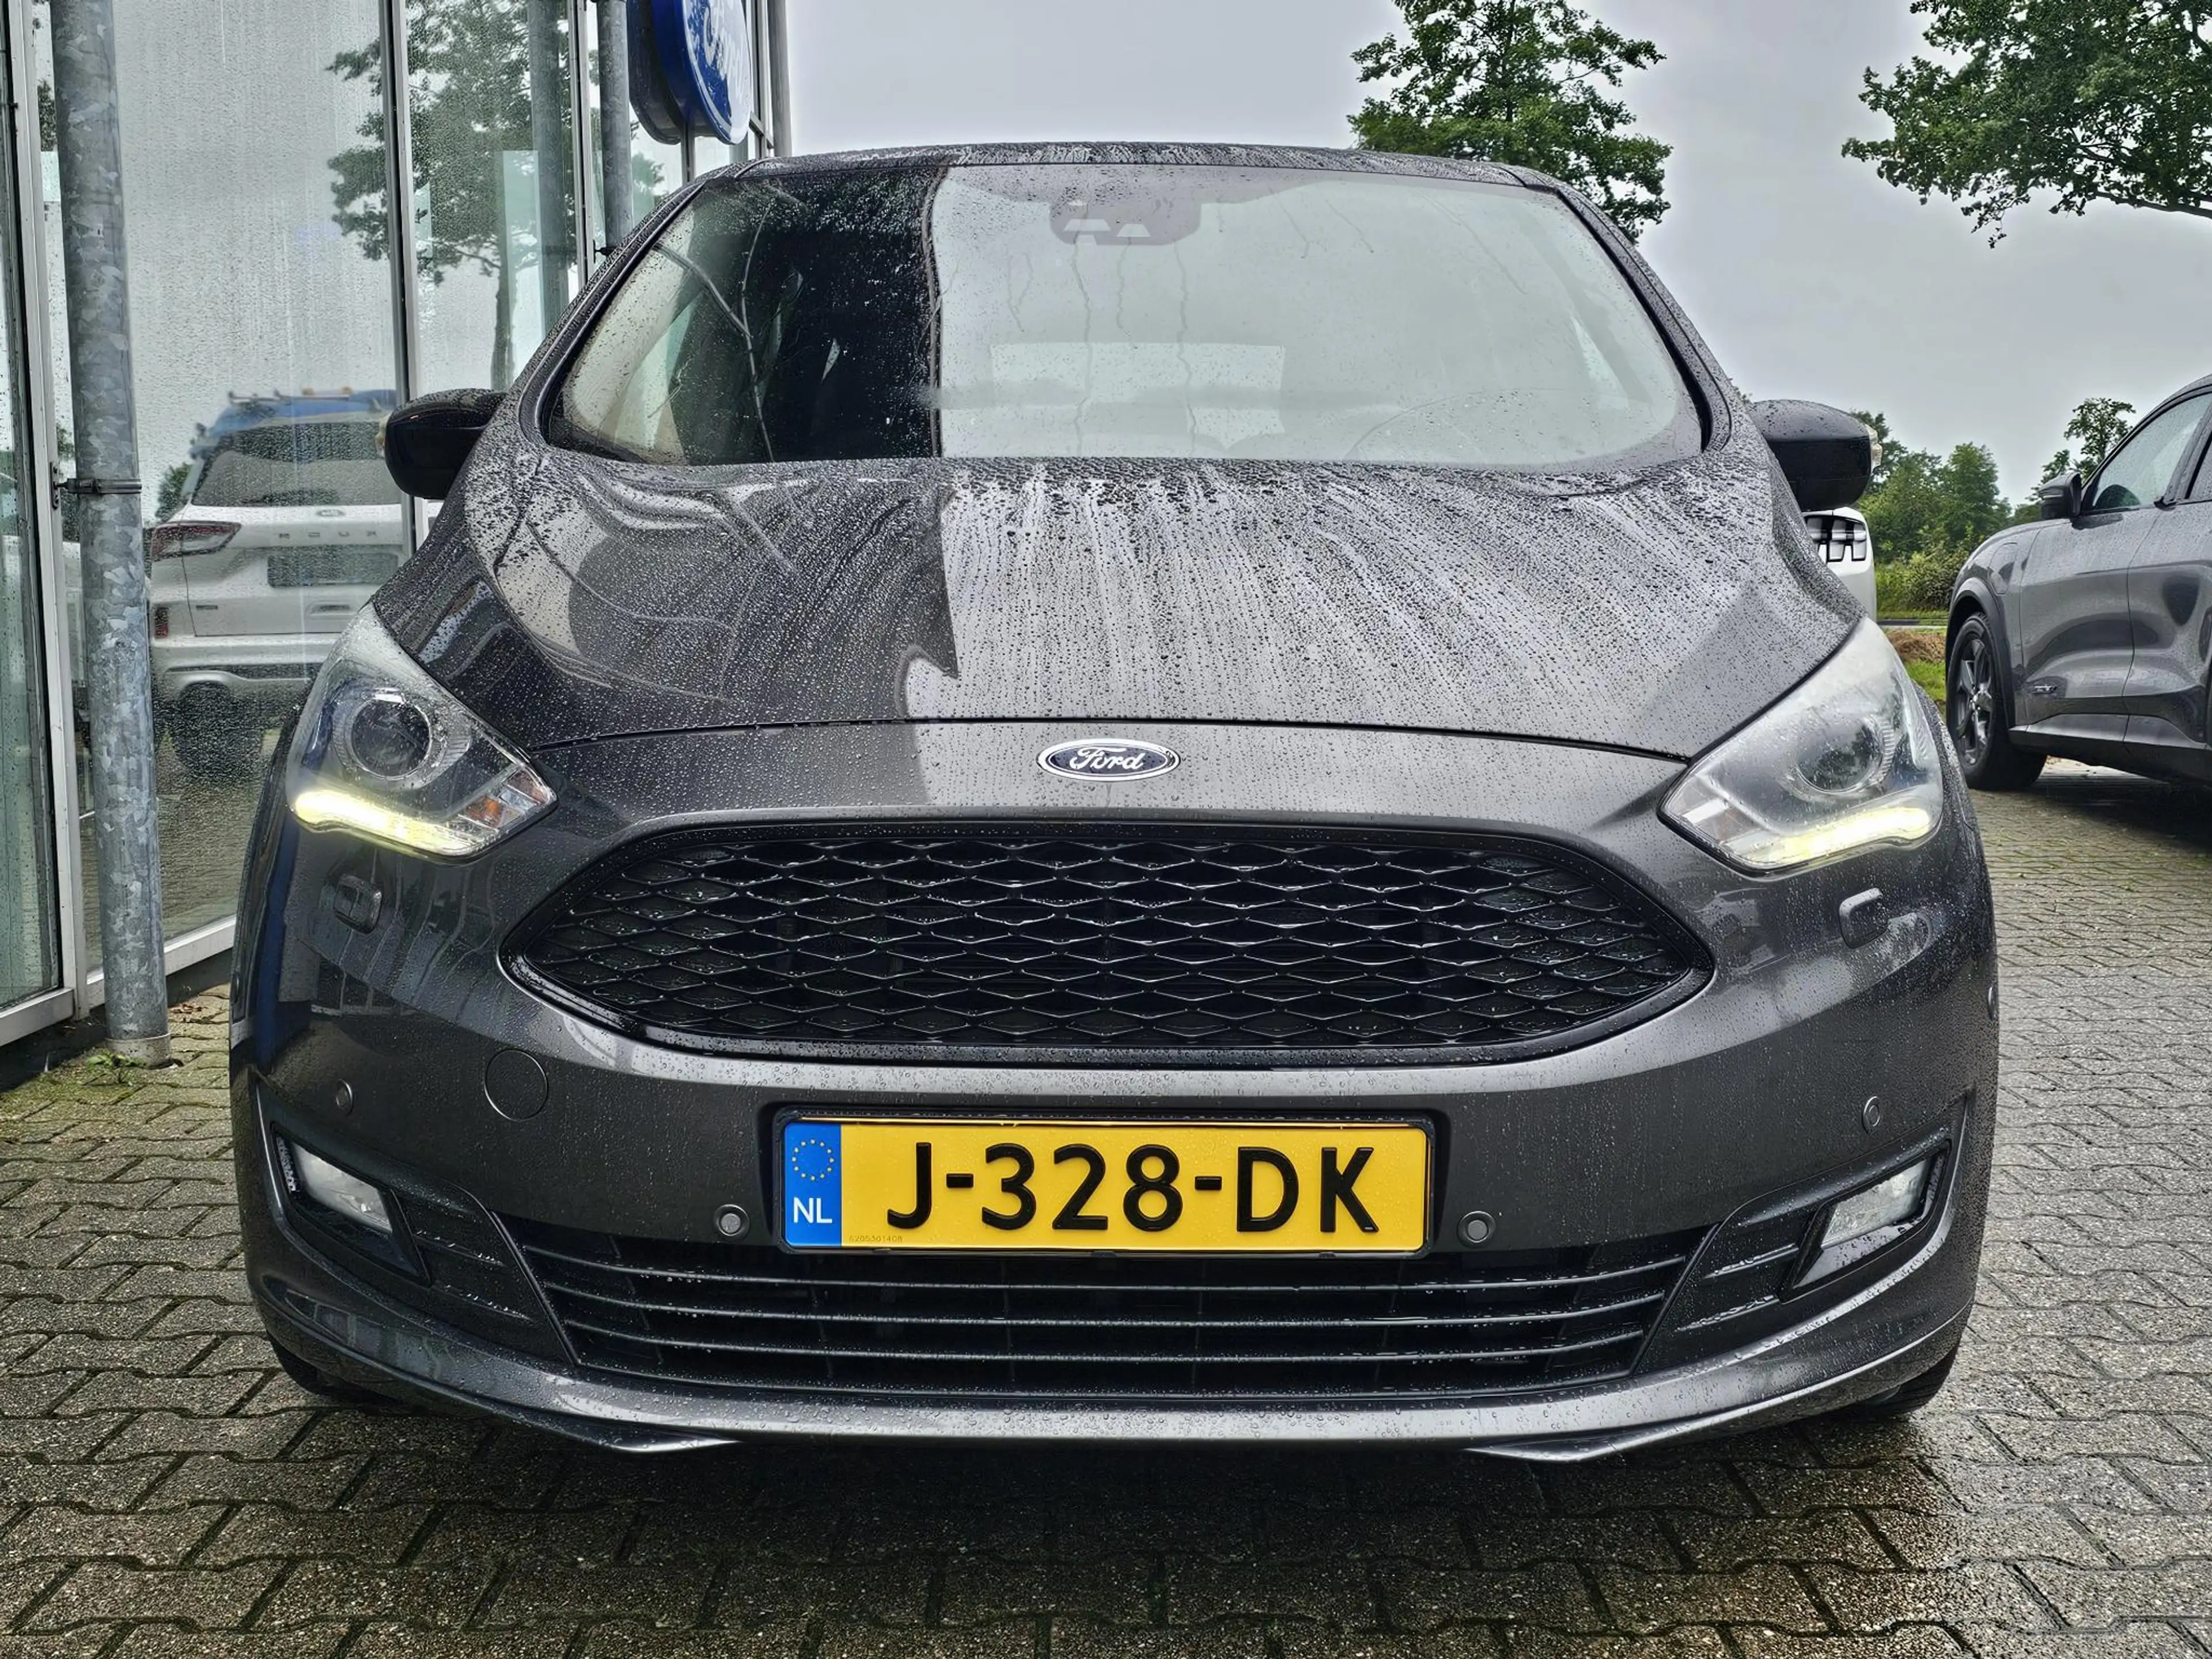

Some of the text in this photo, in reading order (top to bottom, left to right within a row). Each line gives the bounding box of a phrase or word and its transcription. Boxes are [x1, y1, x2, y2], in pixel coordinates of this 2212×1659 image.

[1070, 747, 1146, 770] Ford
[887, 1142, 1379, 1232] J-328-DK
[793, 1197, 832, 1224] NL
